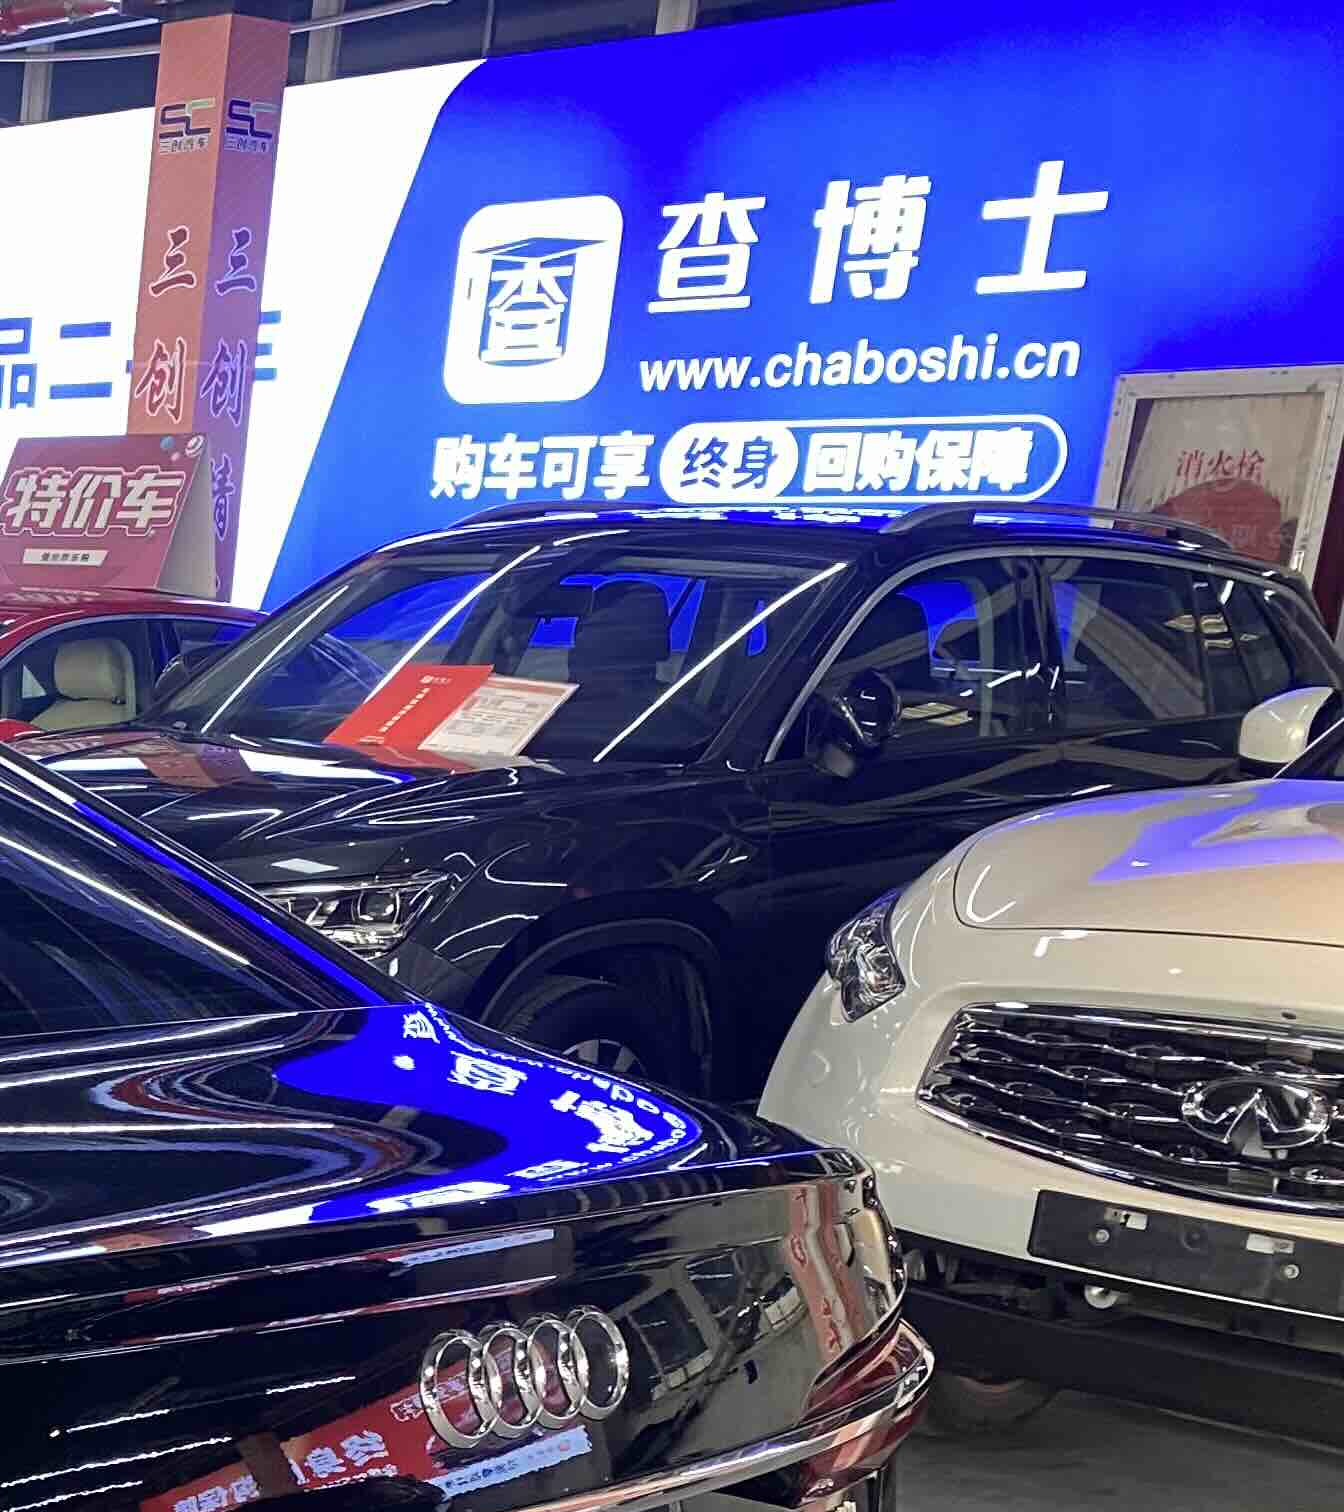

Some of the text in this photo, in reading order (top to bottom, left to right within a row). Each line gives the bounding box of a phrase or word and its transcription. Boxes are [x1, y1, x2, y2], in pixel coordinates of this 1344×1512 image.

[647, 159, 1110, 315] 查博士
[639, 331, 1081, 394] www.chaboshi.cn
[429, 428, 1035, 500] 购车可享 终身 回购保障
[1, 469, 186, 533] 特价车
